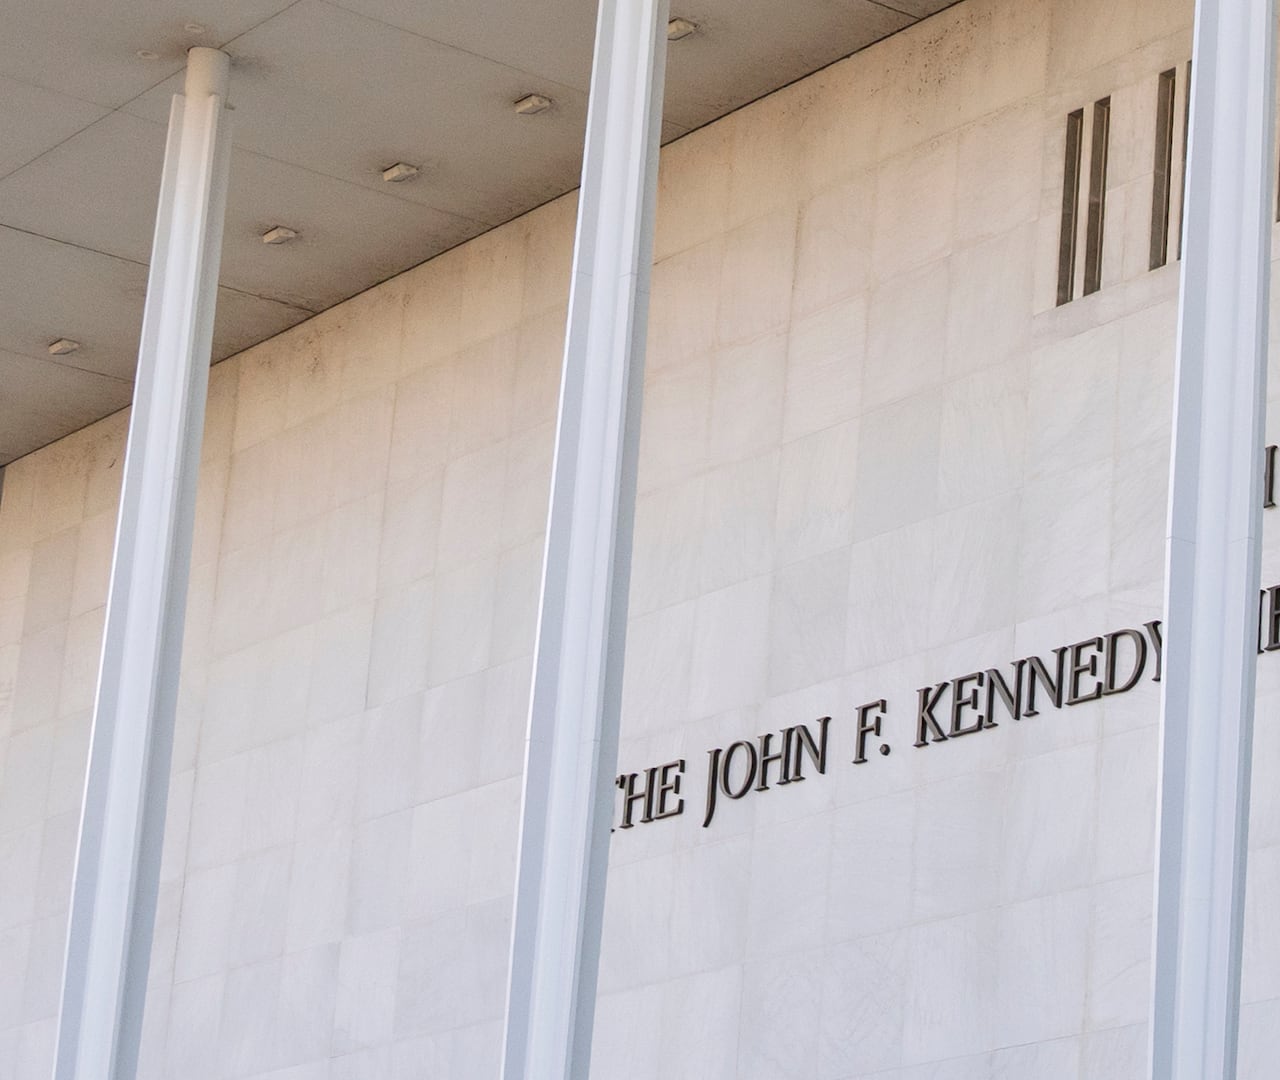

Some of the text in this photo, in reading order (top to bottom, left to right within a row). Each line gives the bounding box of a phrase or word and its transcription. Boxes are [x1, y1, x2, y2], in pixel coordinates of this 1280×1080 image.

[611, 758, 686, 833] HE
[702, 716, 832, 829] JOHN
[852, 698, 891, 765] F.
